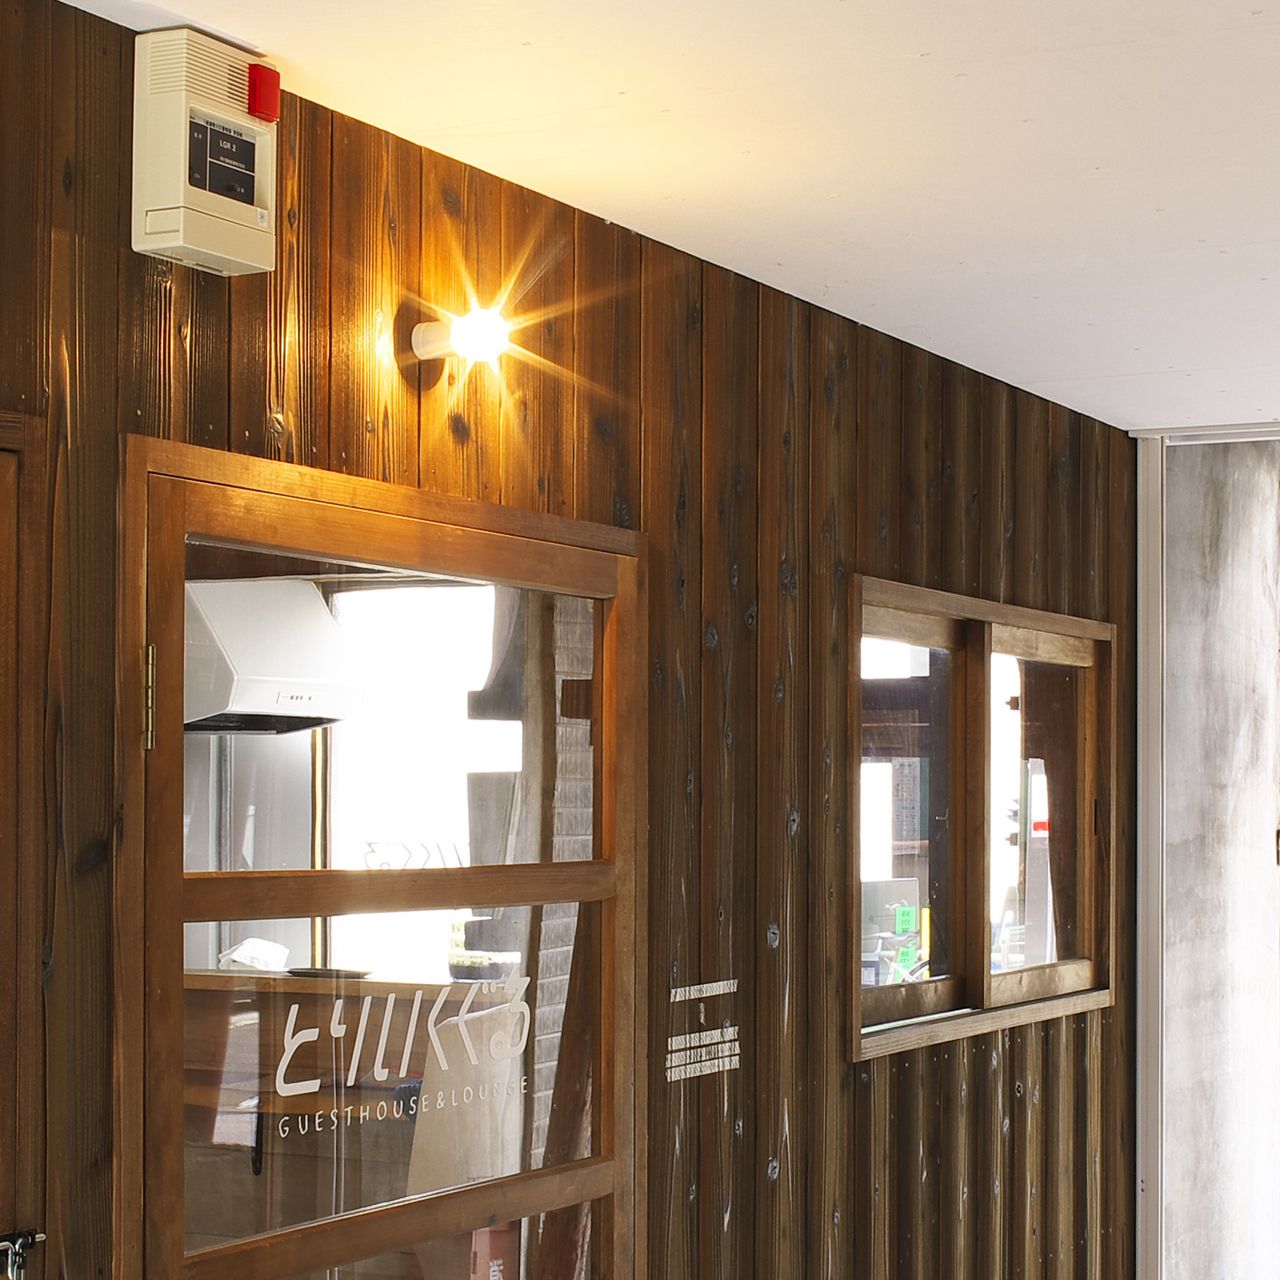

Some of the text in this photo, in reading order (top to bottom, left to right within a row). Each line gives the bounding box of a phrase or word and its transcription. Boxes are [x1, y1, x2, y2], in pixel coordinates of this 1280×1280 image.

[275, 977, 531, 1097] とりいくぐる
